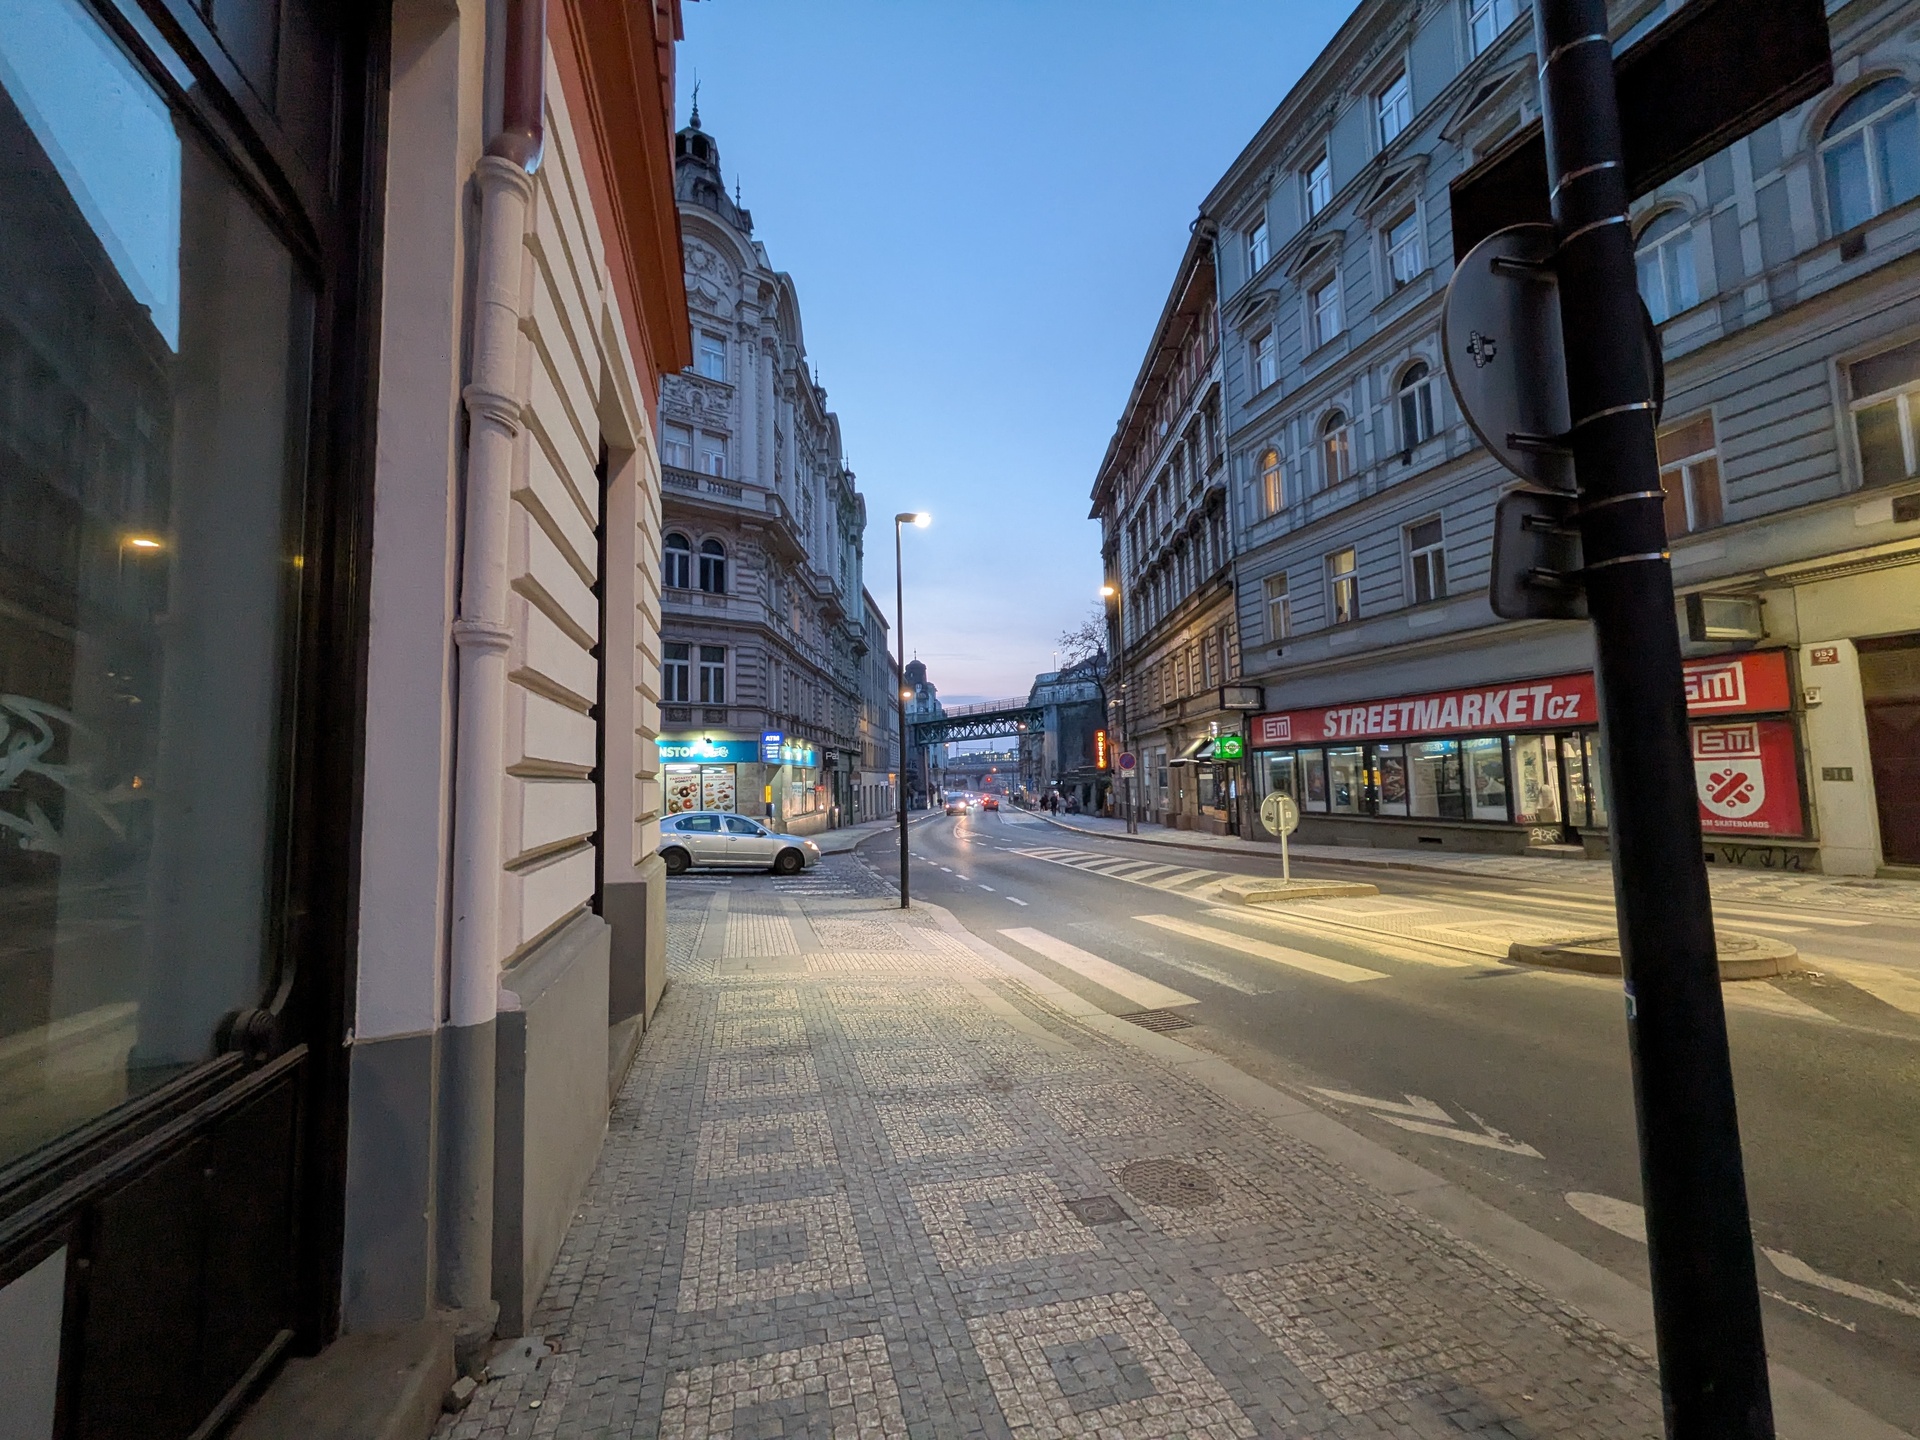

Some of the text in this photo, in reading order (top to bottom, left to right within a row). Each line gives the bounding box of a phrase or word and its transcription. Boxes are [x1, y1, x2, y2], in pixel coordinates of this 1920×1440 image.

[1701, 730, 1751, 751] SM
[1701, 819, 1770, 829] SM SKATEBOARDS
